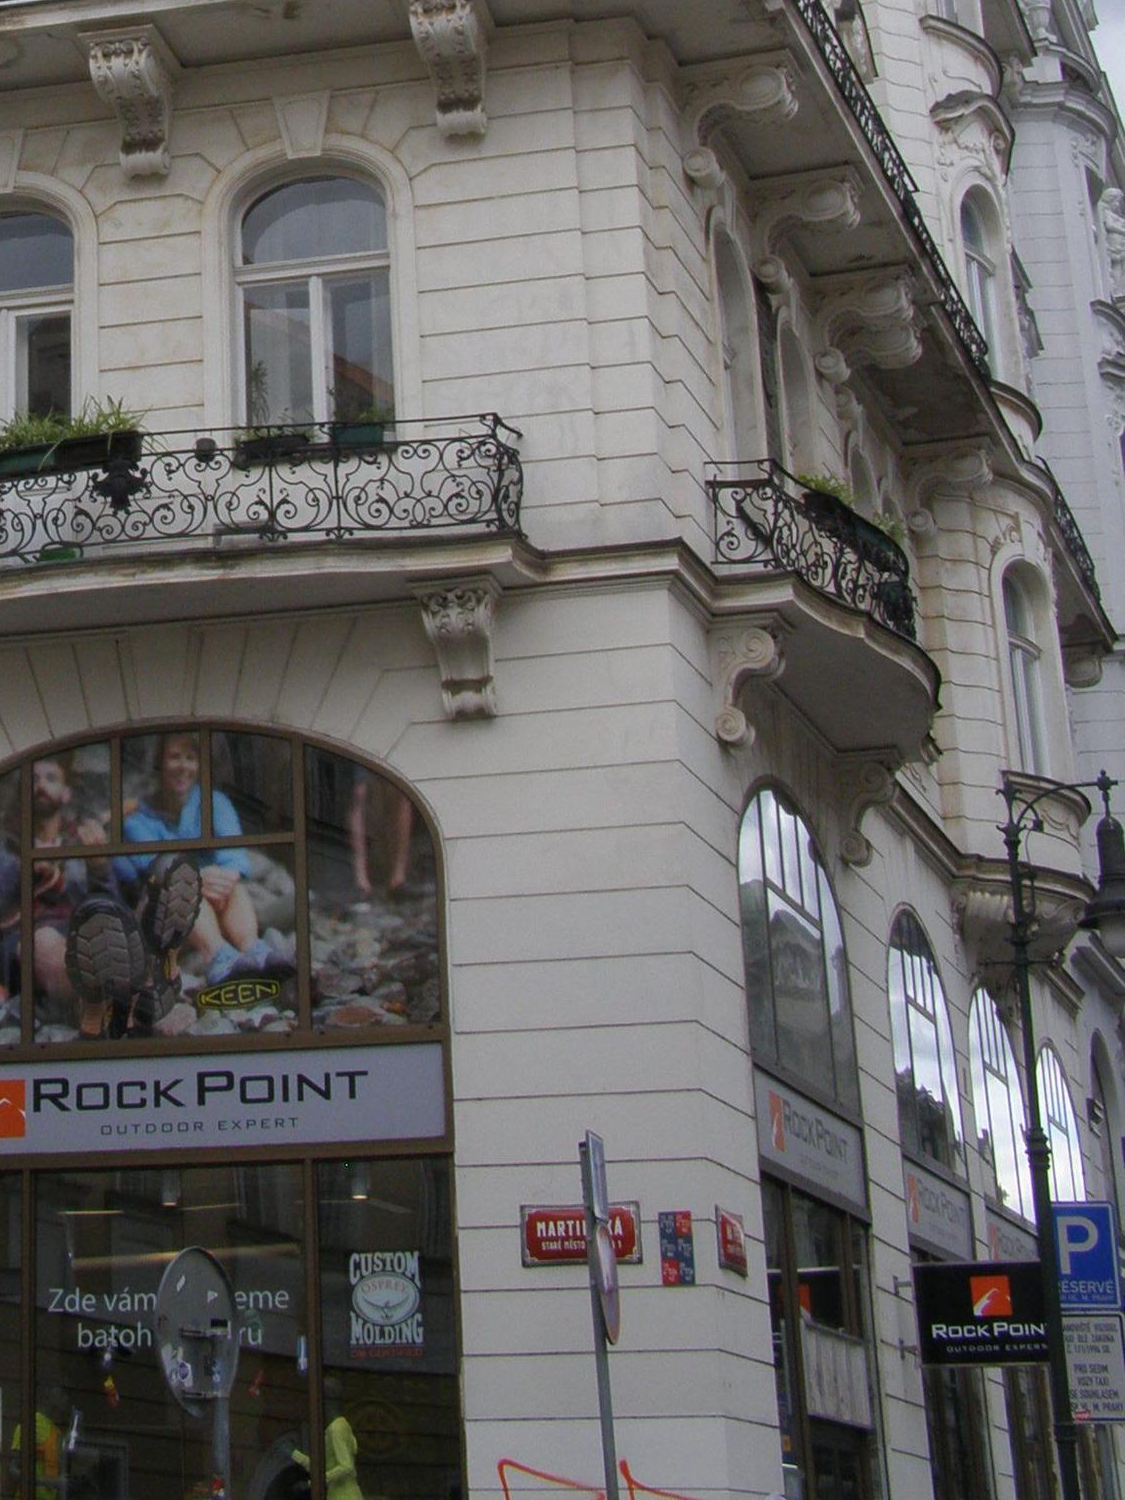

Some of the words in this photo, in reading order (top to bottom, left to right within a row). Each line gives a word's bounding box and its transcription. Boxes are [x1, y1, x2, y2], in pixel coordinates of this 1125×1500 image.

[200, 983, 277, 1005] KEEN
[100, 1120, 204, 1137] OUTDOOR
[217, 1116, 300, 1132] EXPERT
[536, 1215, 623, 1238] MARTIKÁ
[541, 1239, 562, 1251] STARÉ
[563, 1238, 586, 1250] MĚSTO
[1056, 1215, 1099, 1275] P
[348, 1250, 422, 1289] CUSTOM
[1058, 1277, 1114, 1294] ÉSERVÉ
[47, 1287, 96, 1313] Zde
[103, 1286, 158, 1312] vám
[77, 1320, 153, 1348] batoh
[349, 1311, 425, 1345] MOLDING
[993, 1321, 1047, 1337] POIN
[946, 1345, 1000, 1353] OUTDOOR
